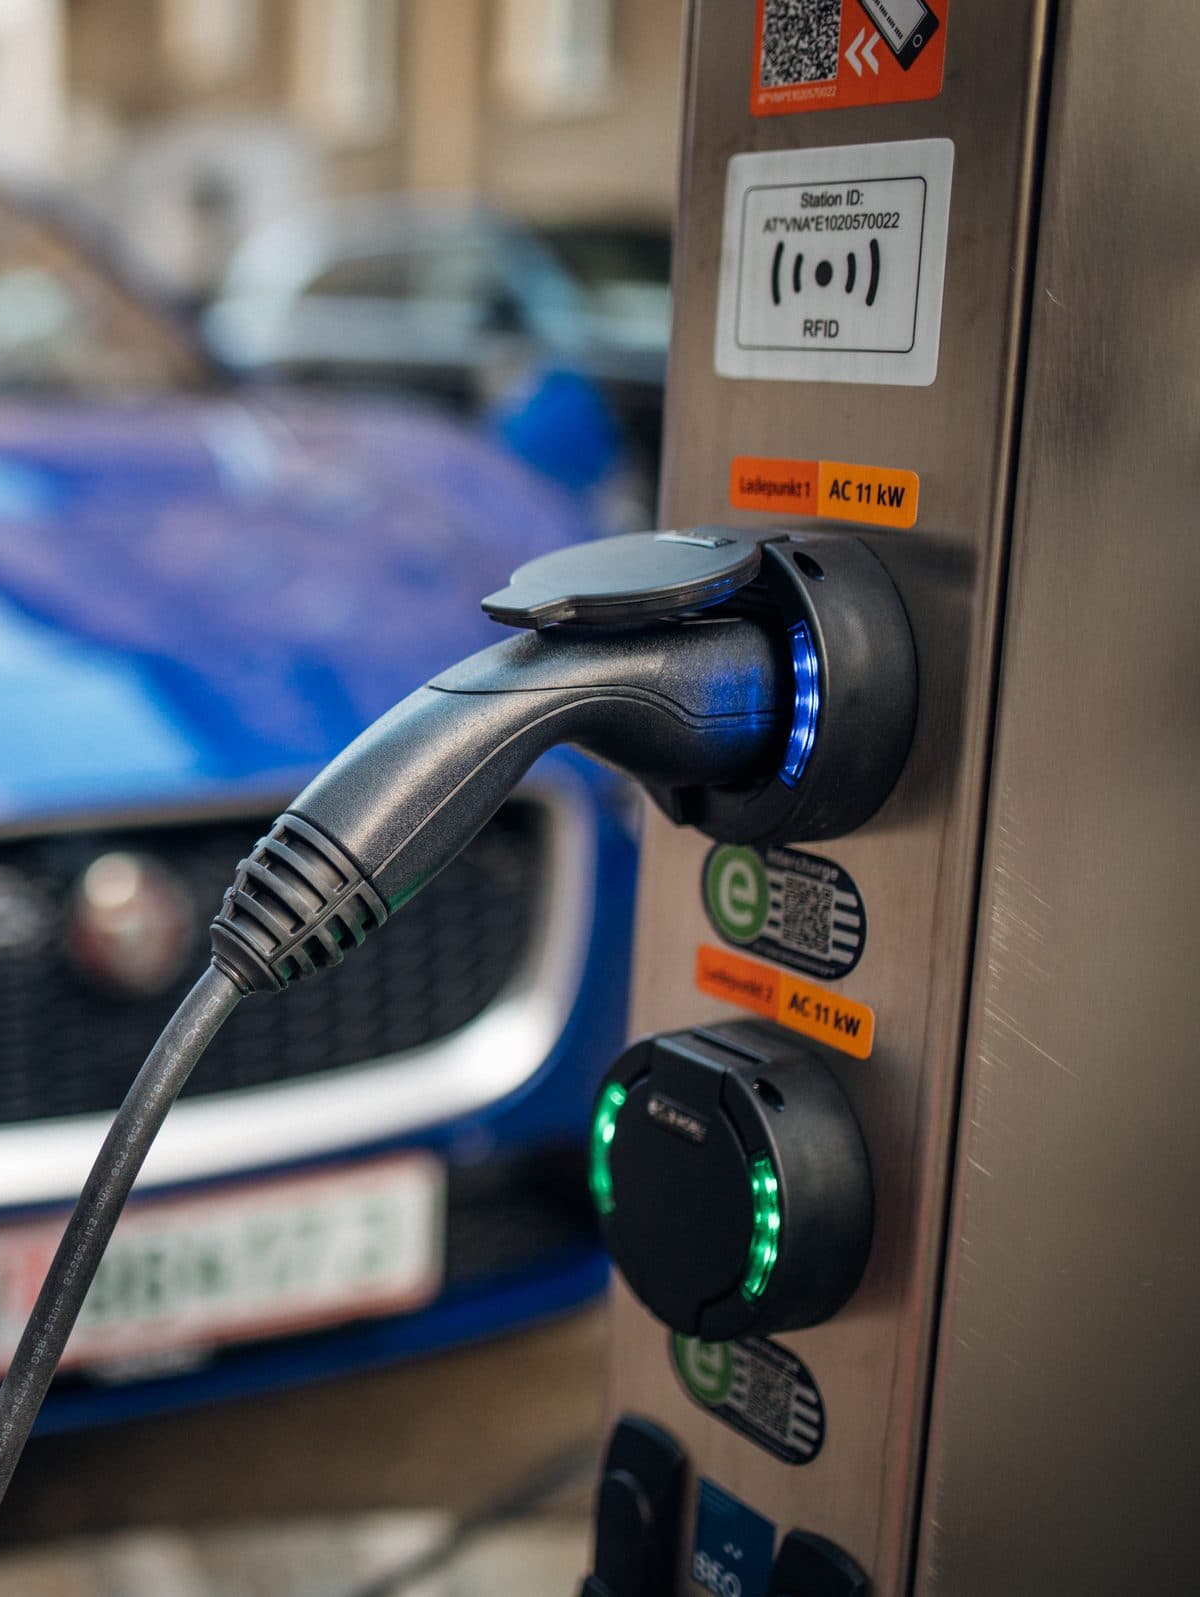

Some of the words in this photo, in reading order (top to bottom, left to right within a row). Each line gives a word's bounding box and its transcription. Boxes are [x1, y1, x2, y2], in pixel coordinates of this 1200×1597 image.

[800, 191, 842, 209] Station
[847, 189, 864, 206] ID:
[803, 319, 839, 339] RFID
[739, 475, 803, 498] Ladepunkt
[805, 480, 811, 498] 1
[829, 479, 852, 501] AC
[856, 482, 872, 504] 11
[877, 483, 905, 508] kW
[788, 992, 810, 1018] AC
[814, 1002, 830, 1025] 11
[834, 1010, 861, 1037] kW
